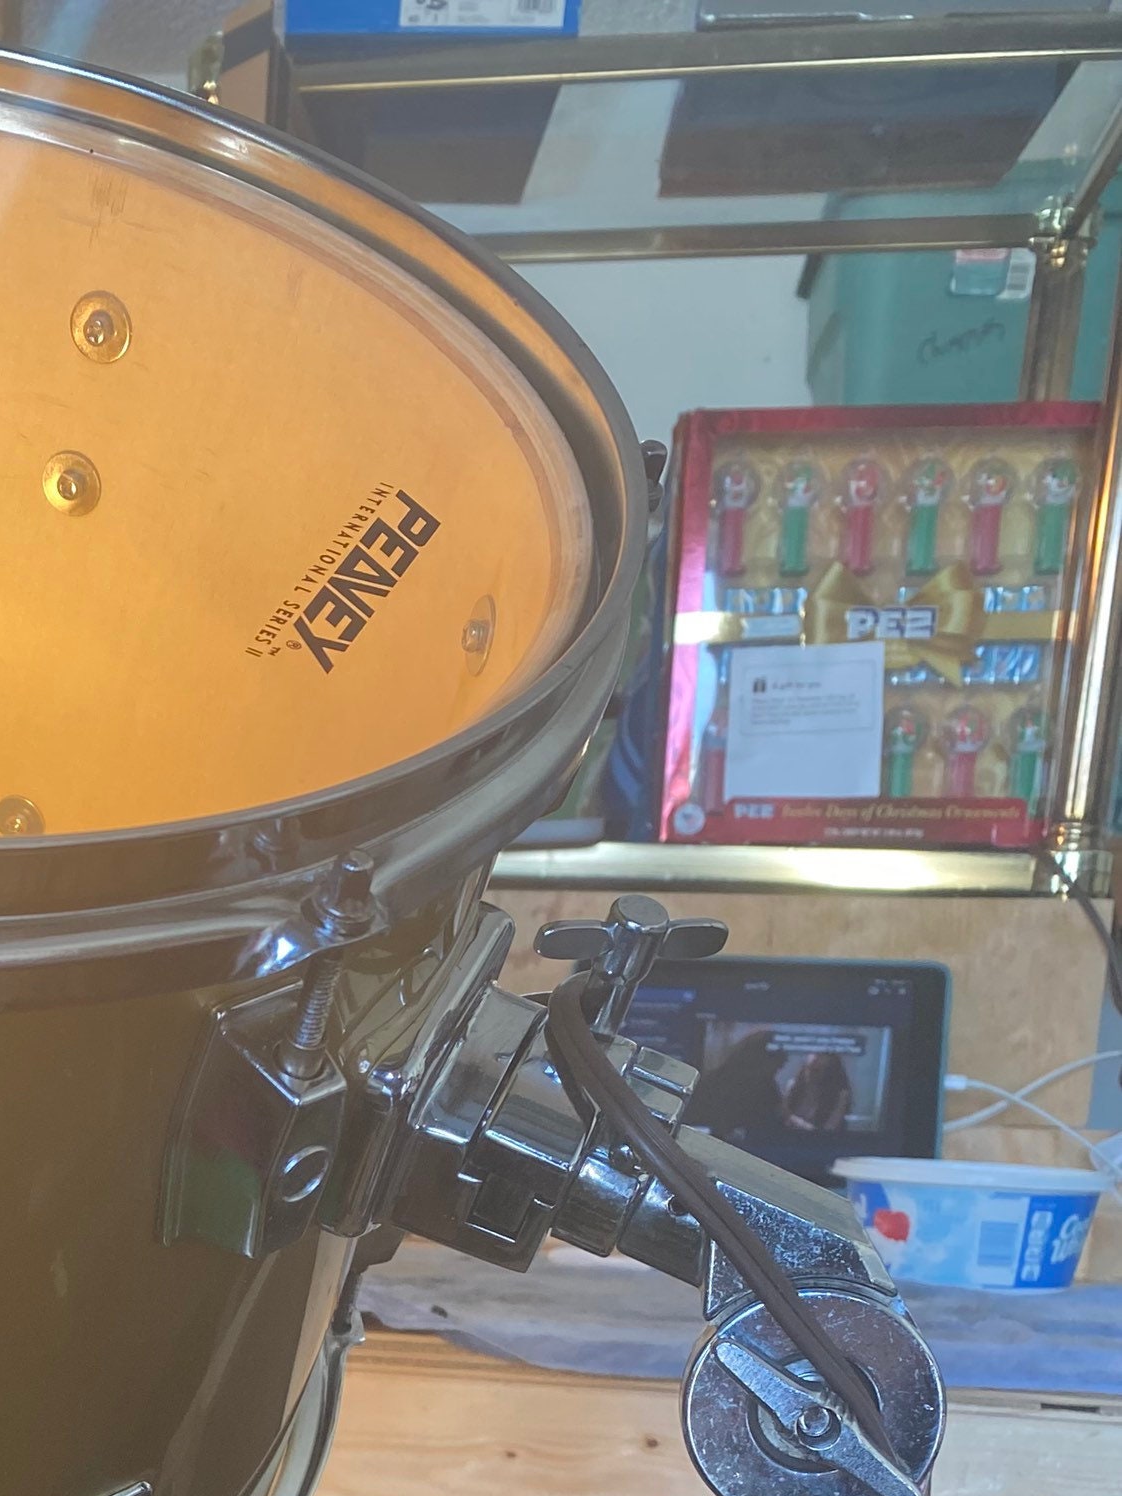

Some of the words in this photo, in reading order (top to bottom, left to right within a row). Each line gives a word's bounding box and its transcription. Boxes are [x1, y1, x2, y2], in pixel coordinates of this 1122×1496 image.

[294, 482, 394, 593] INTERNATIONAL
[844, 607, 936, 639] PEZ
[245, 647, 264, 657] II
[734, 804, 774, 819] PEZ
[827, 804, 858, 819] Days
[860, 805, 877, 821] of
[877, 804, 942, 818] Christmas
[945, 804, 1020, 819] Ornaments
